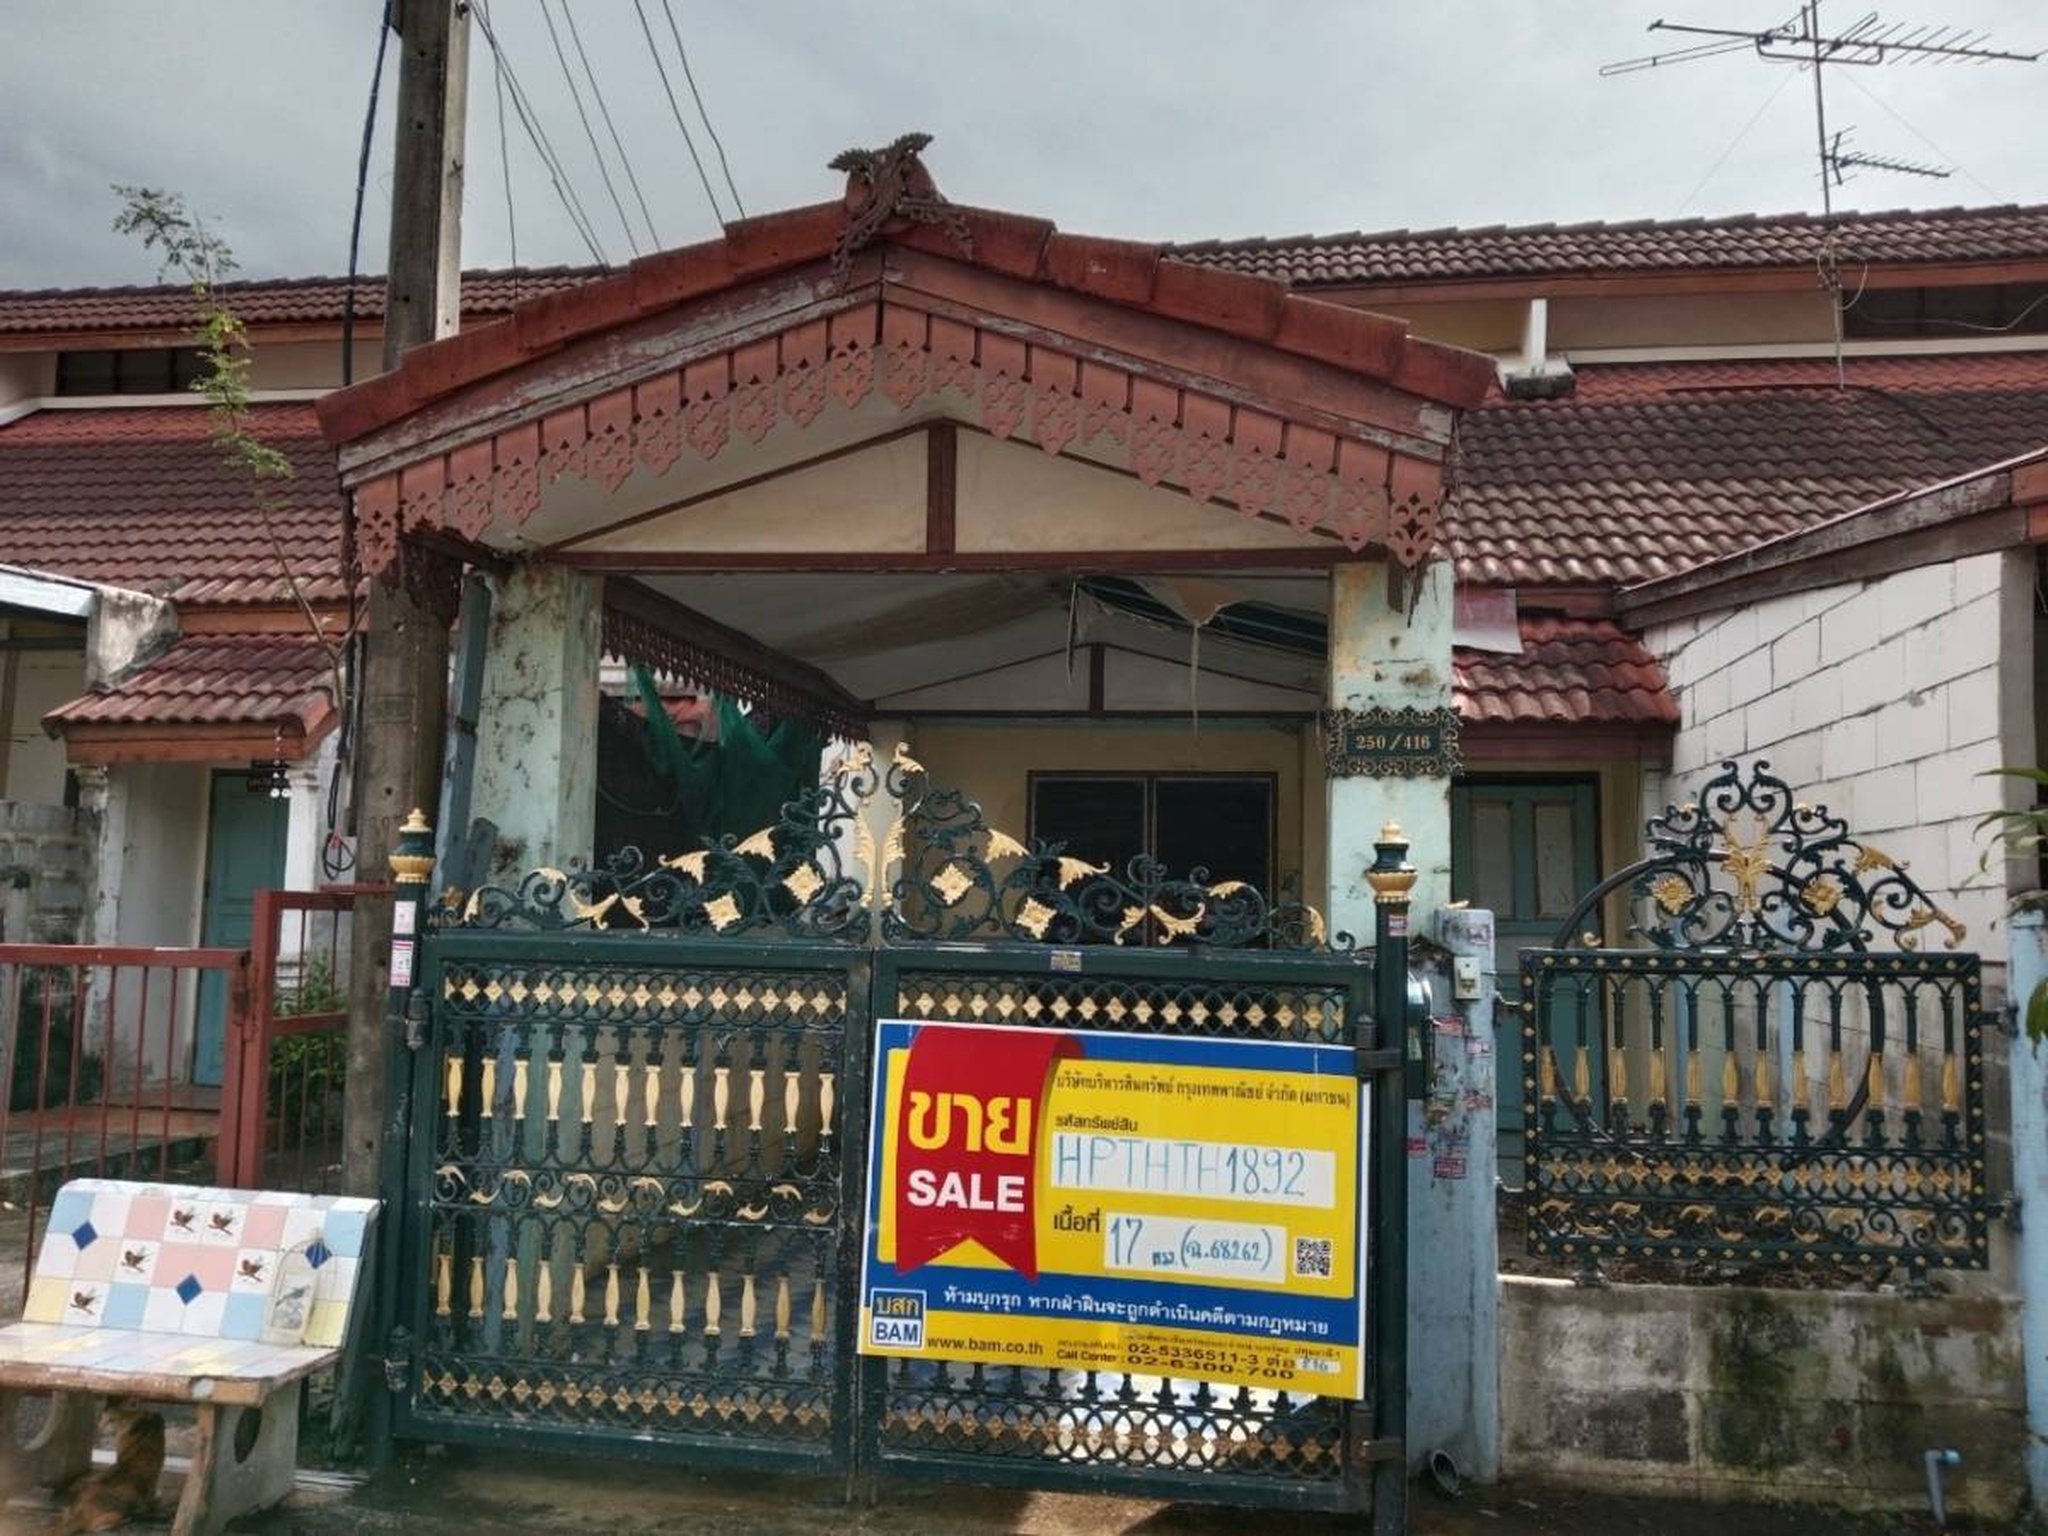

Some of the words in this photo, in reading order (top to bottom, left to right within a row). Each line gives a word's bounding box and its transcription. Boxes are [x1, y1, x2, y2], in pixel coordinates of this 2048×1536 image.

[908, 1091, 1032, 1155] ขาย
[1057, 1134, 1306, 1198] HPTHTH1892
[906, 1168, 1026, 1213] SALE
[1053, 1203, 1101, 1234] เนื้อที่
[1110, 1217, 1144, 1266] 17
[876, 1296, 920, 1317] บสก
[943, 1284, 1021, 1313] ห้ามบุกรุก
[874, 1321, 919, 1343] BAM
[927, 1336, 1045, 1356] www.bam.co.th
[1056, 1348, 1078, 1360] Call
[1127, 1354, 1295, 1380] 02-6300-700
